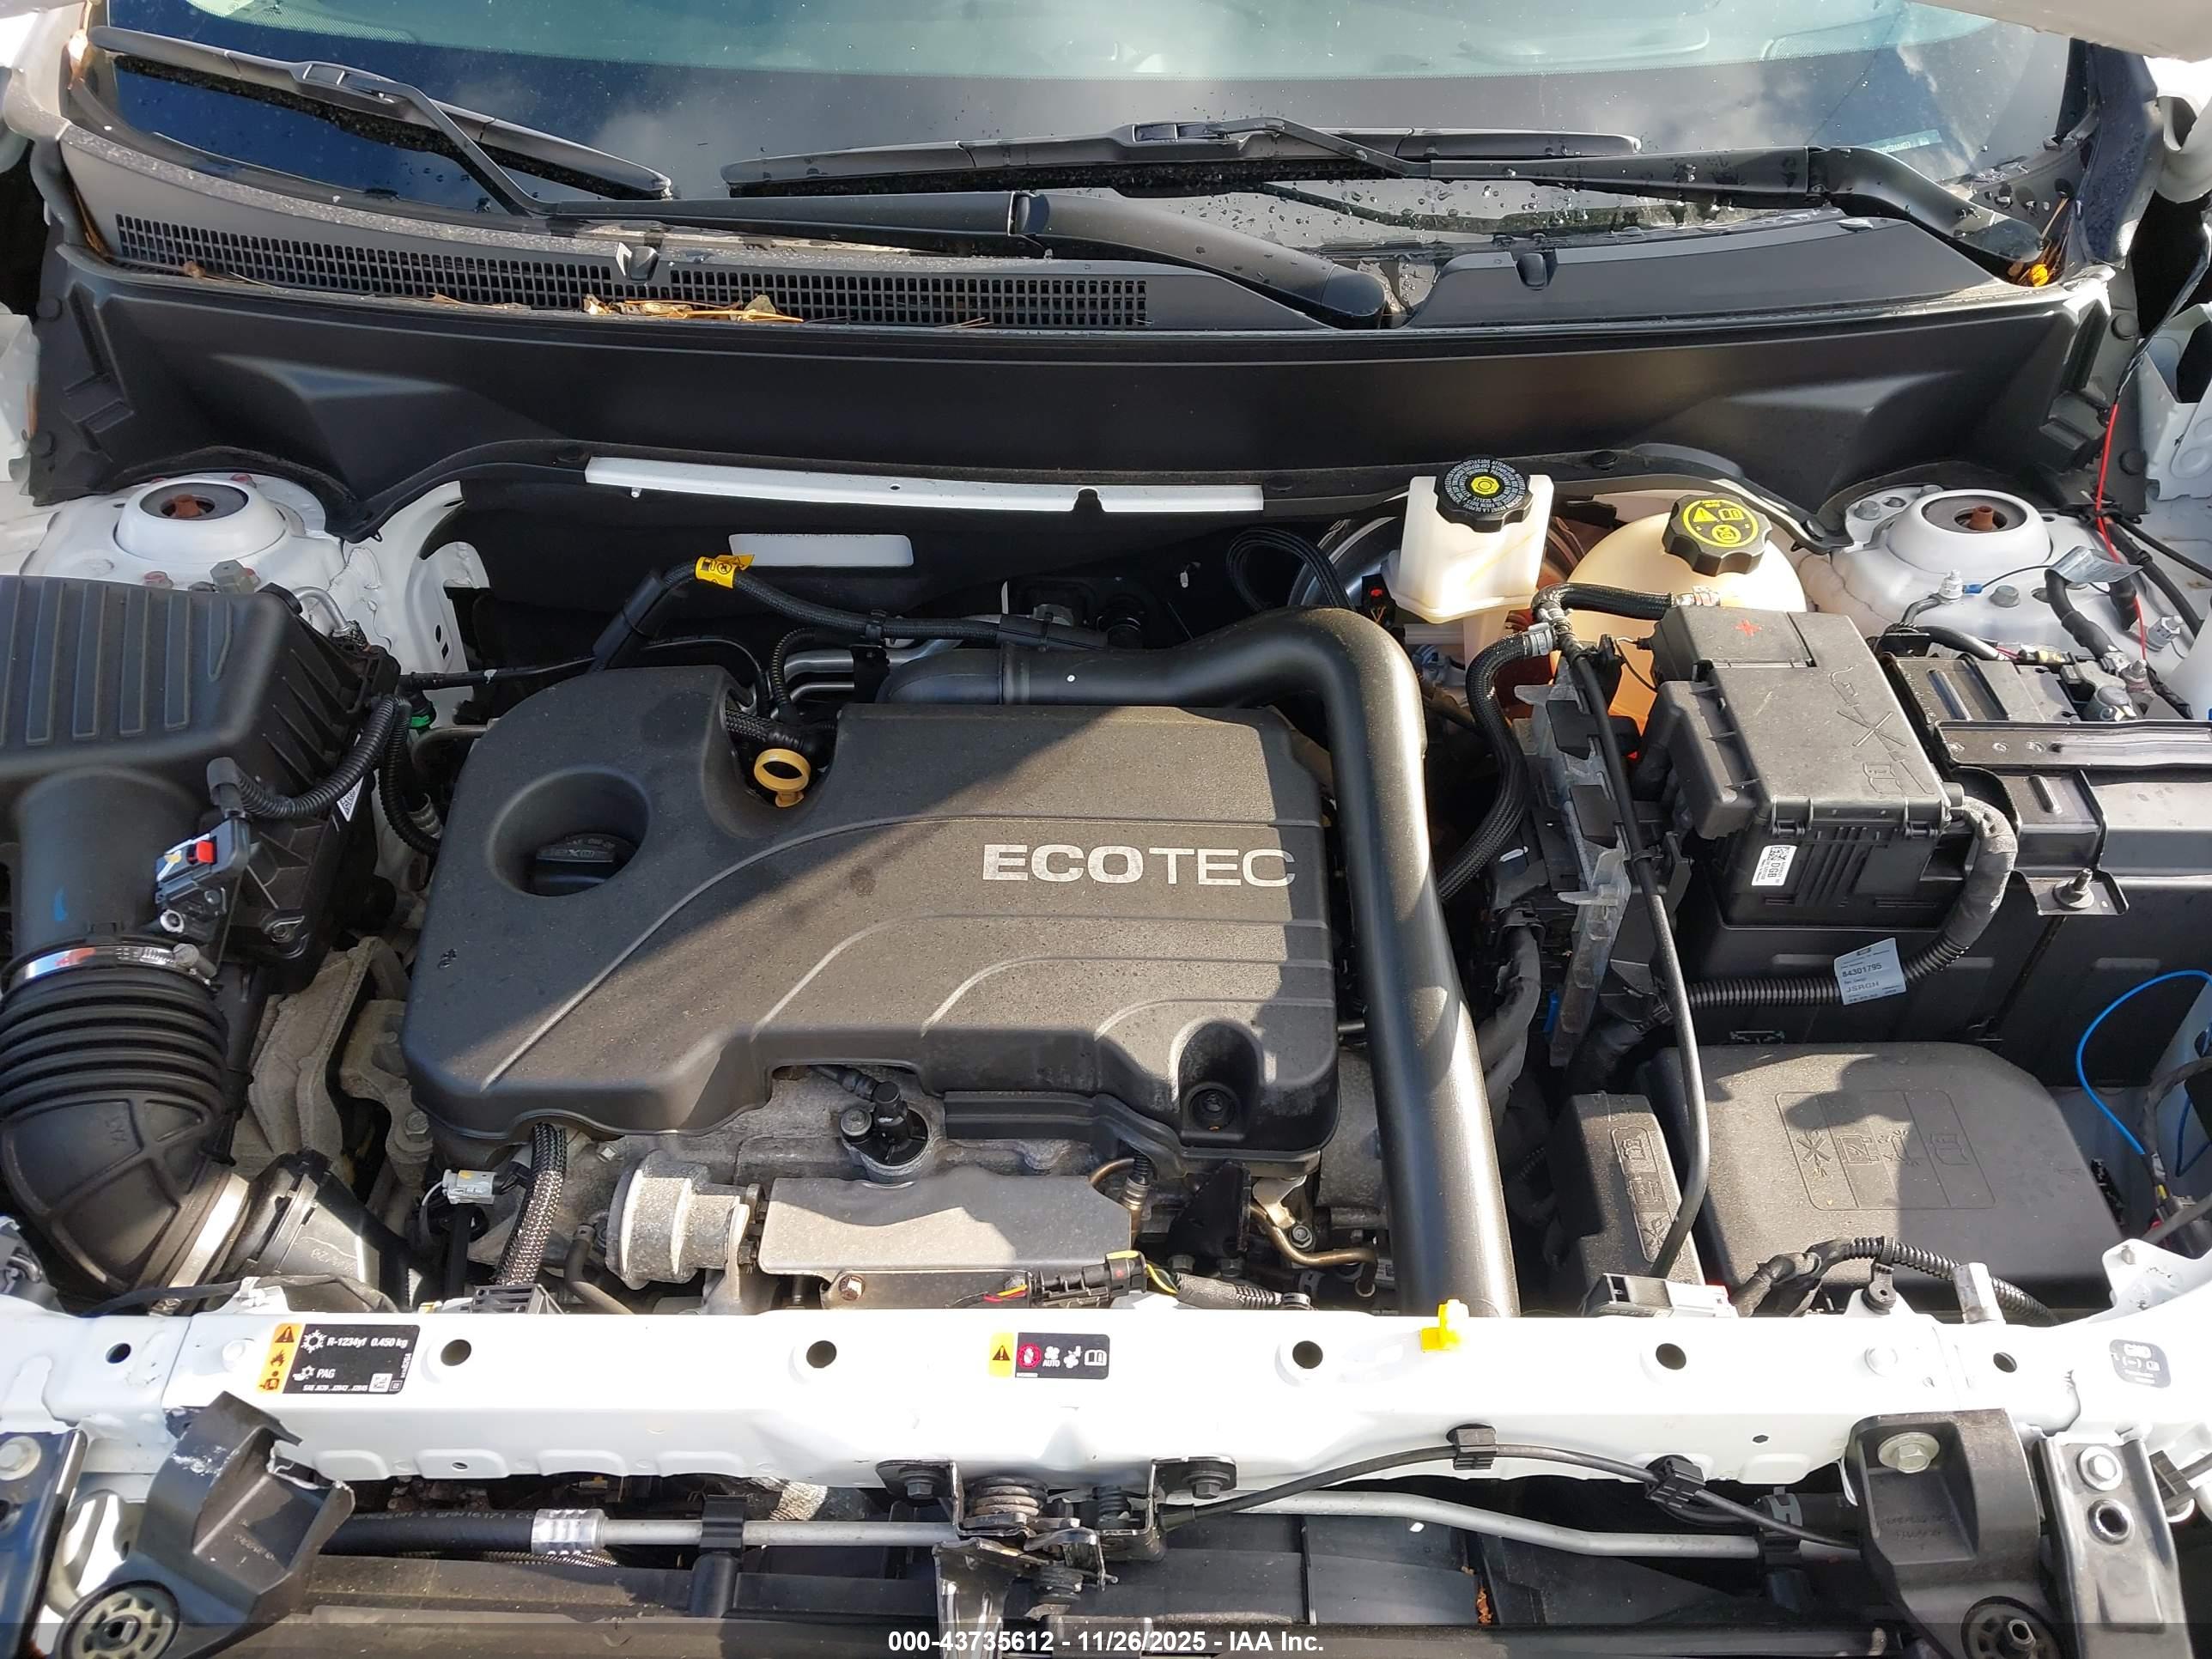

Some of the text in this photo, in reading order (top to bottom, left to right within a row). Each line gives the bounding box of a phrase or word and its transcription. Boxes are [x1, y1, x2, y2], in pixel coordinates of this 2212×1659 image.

[982, 844, 1296, 887] ECOTEC
[1042, 1359, 1060, 1368] AUTO
[316, 1369, 336, 1379] PAG
